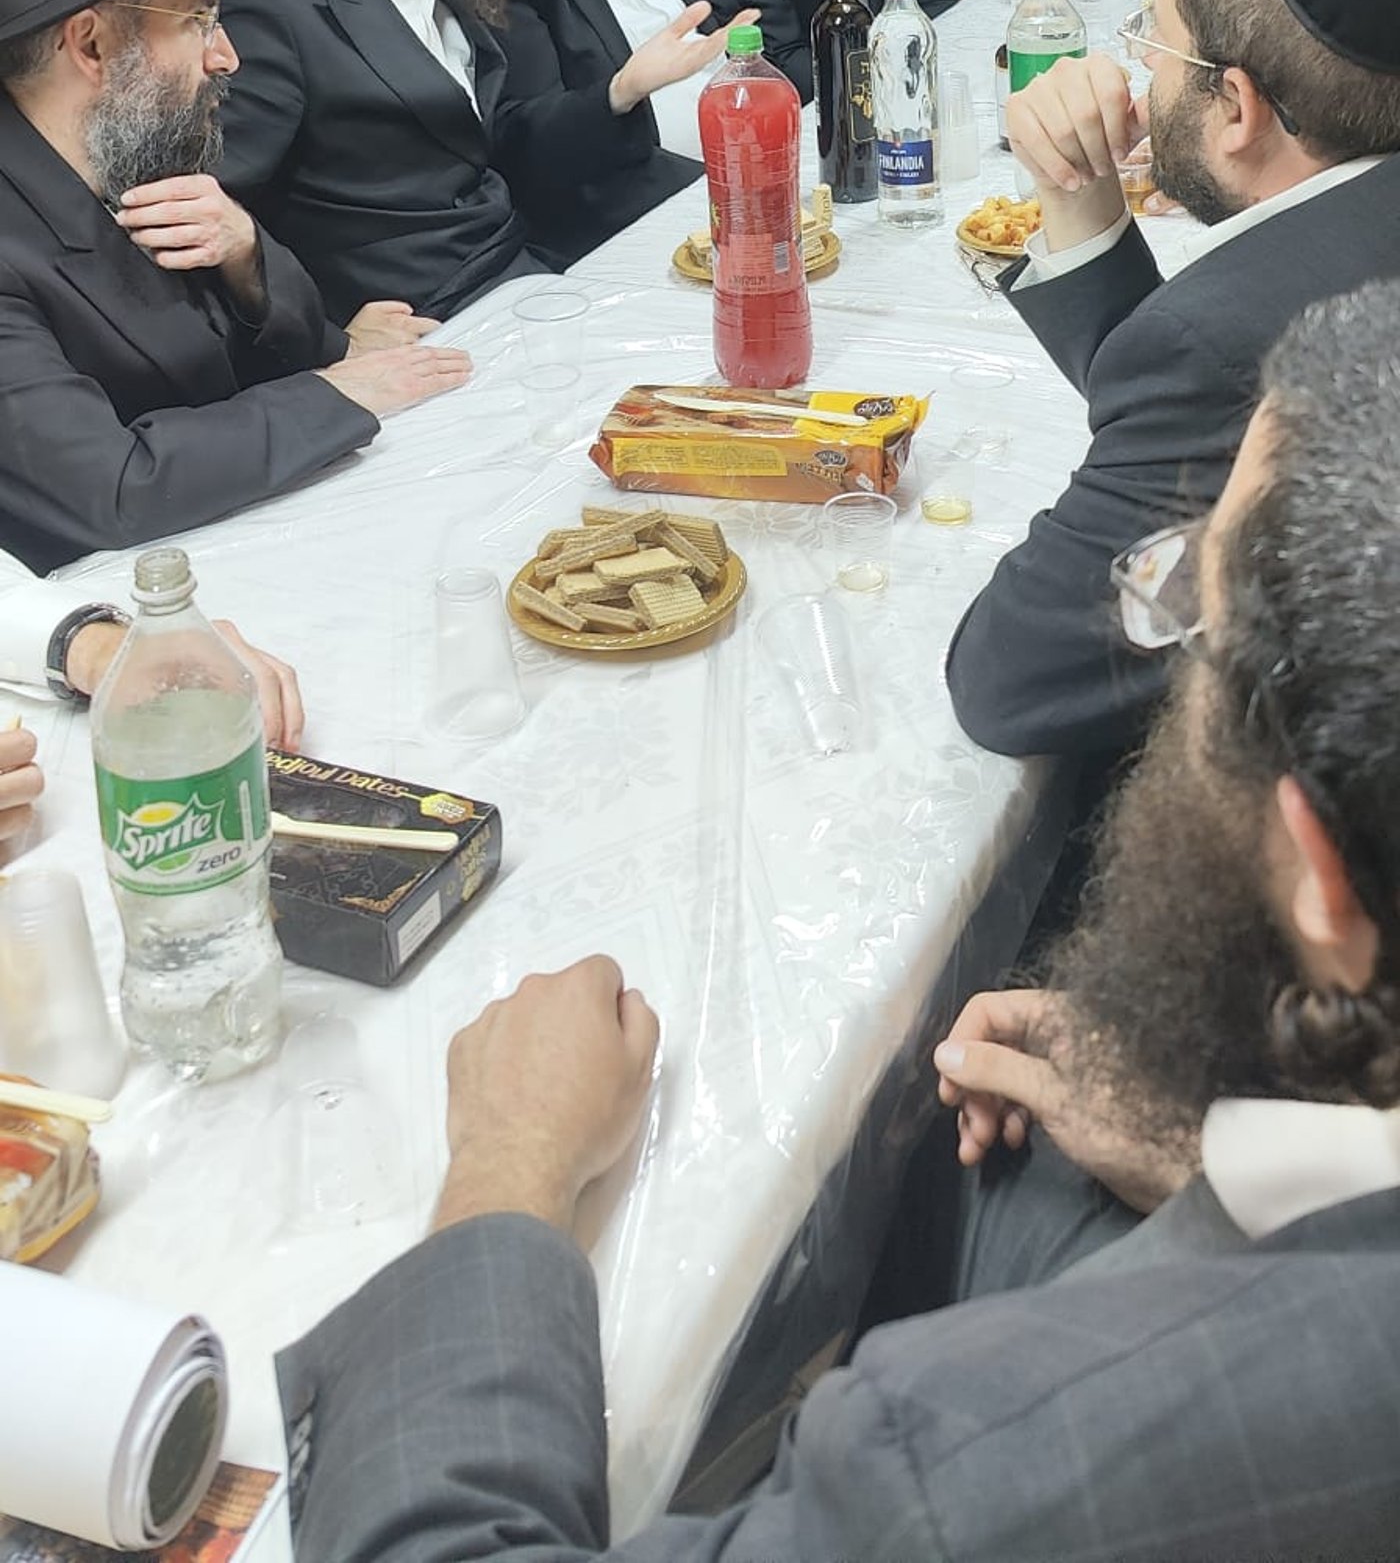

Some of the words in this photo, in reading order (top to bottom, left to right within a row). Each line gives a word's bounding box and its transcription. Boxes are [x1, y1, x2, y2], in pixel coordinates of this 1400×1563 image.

[879, 153, 925, 170] FINLANDIA
[335, 770, 409, 798] Dates
[120, 808, 213, 865] Sprite
[197, 846, 241, 873] zero
